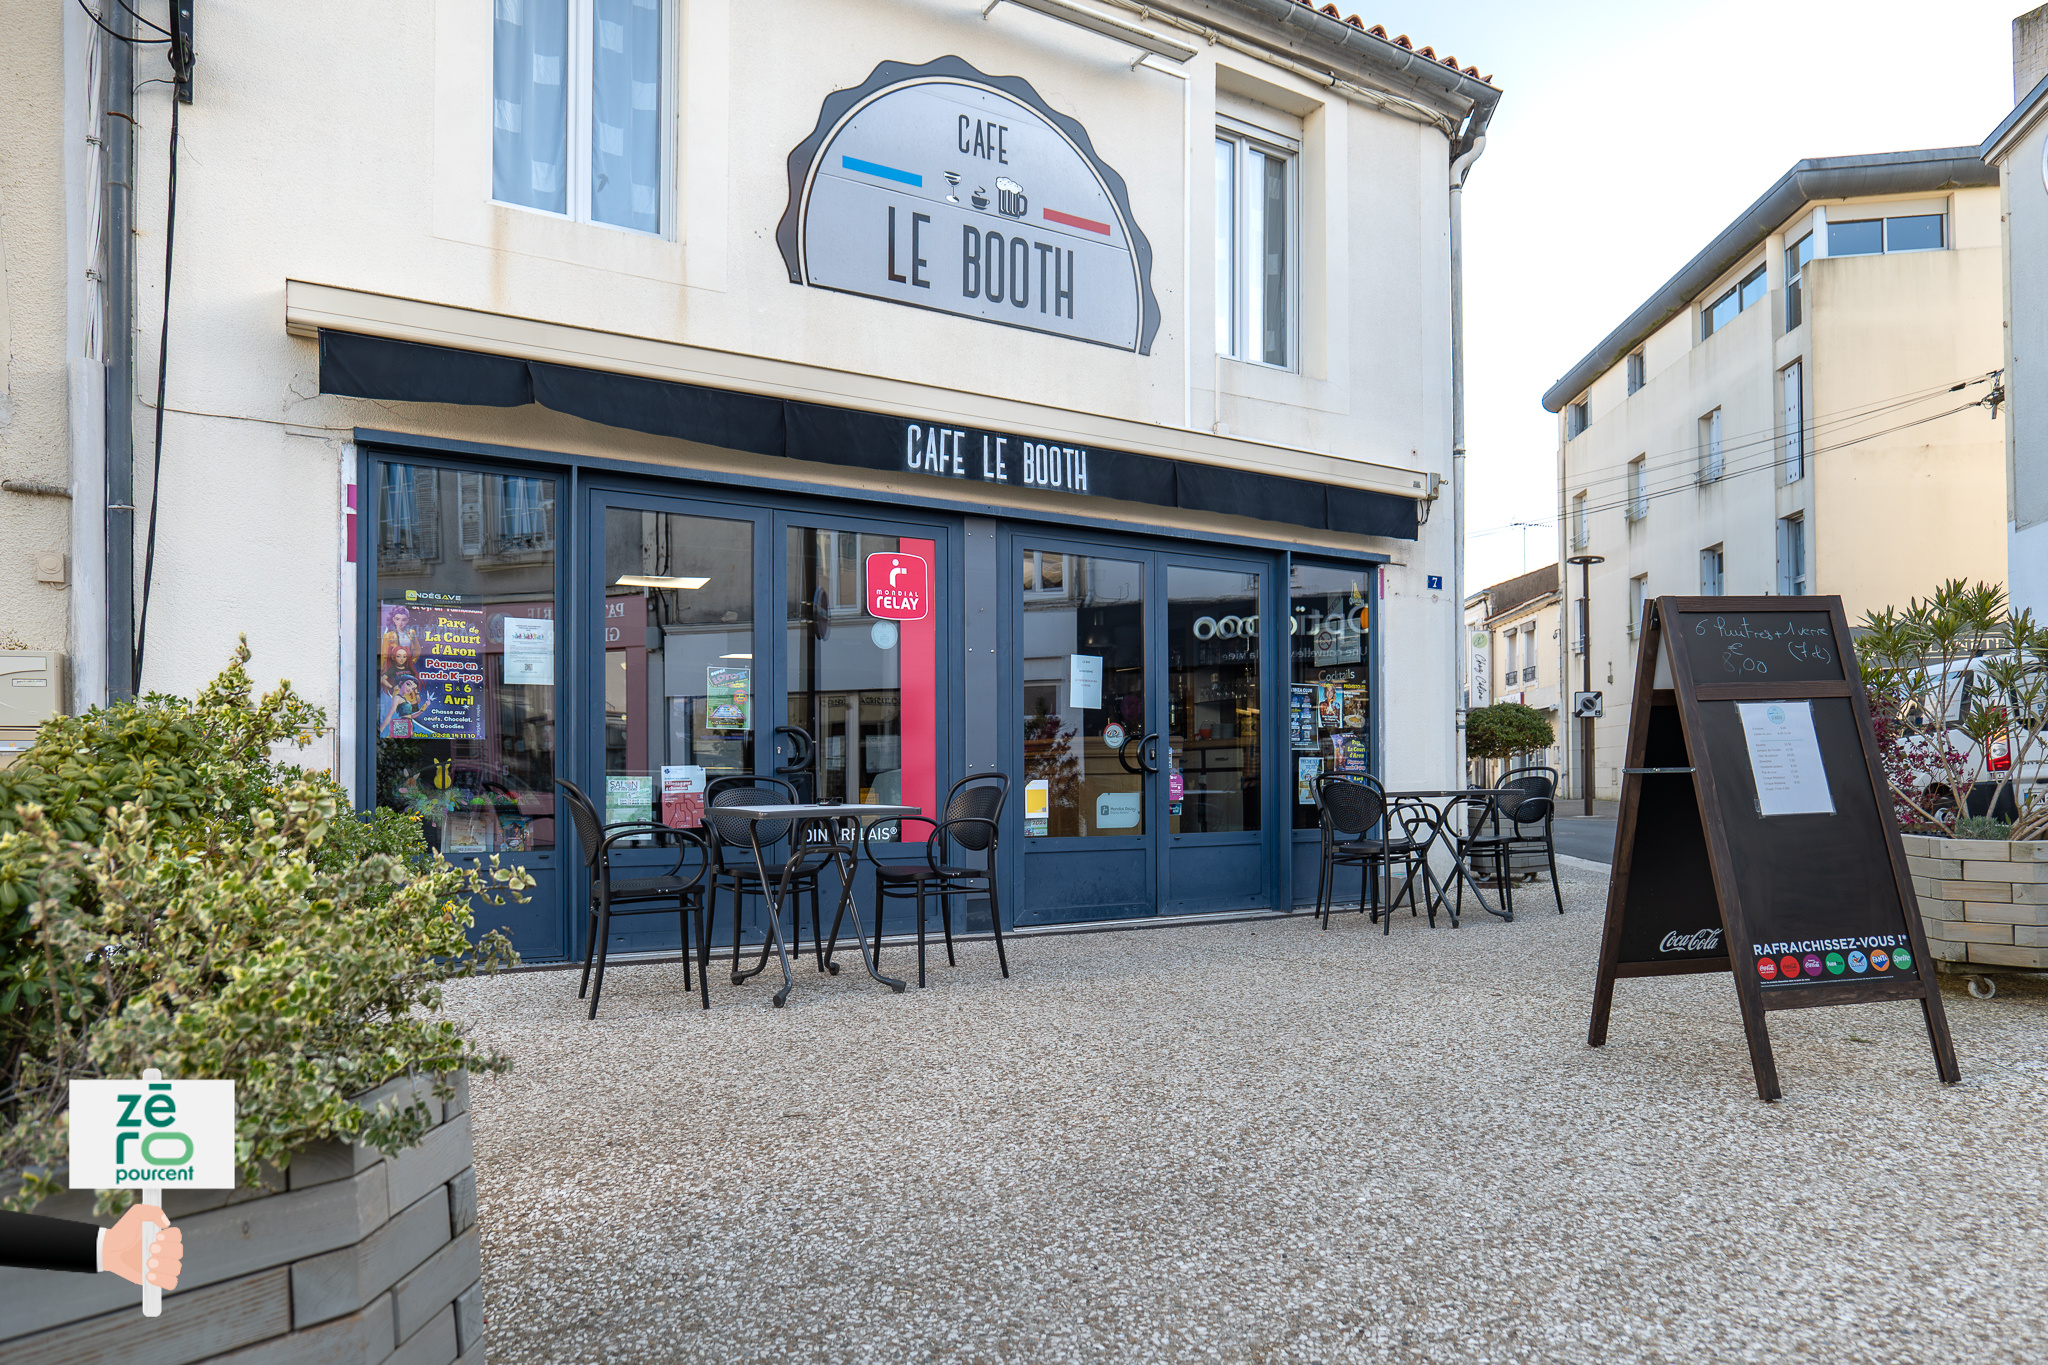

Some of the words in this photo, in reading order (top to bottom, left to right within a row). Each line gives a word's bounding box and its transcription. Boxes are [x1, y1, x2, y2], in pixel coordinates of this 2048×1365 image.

[958, 114, 1009, 165] CAFE
[888, 206, 931, 289] LE
[963, 224, 1074, 319] BOOTH
[907, 424, 966, 475] CAFE
[983, 435, 1008, 480] LE
[1023, 441, 1087, 491] BOOTH
[1432, 577, 1438, 588] 7
[438, 617, 466, 628] Parc
[1695, 619, 1708, 635] 6
[1797, 627, 1828, 636] verre
[425, 631, 441, 642] La
[443, 632, 481, 644] Court
[431, 643, 476, 657] d'Aron
[1728, 643, 1744, 656] €
[426, 659, 463, 670] Pâques
[465, 662, 478, 670] en
[1722, 652, 1767, 675] 8,00
[420, 672, 448, 681] mode
[450, 672, 483, 683] K-pop
[1318, 669, 1355, 681] Cocktails
[444, 683, 453, 692] 5
[463, 684, 472, 693] 6
[444, 695, 474, 705] Avril
[1659, 928, 1724, 952] Coca-Cola
[1753, 935, 1896, 955] RAFRAICHISSEZ-VOUS
[1893, 954, 1911, 964] Sprite
